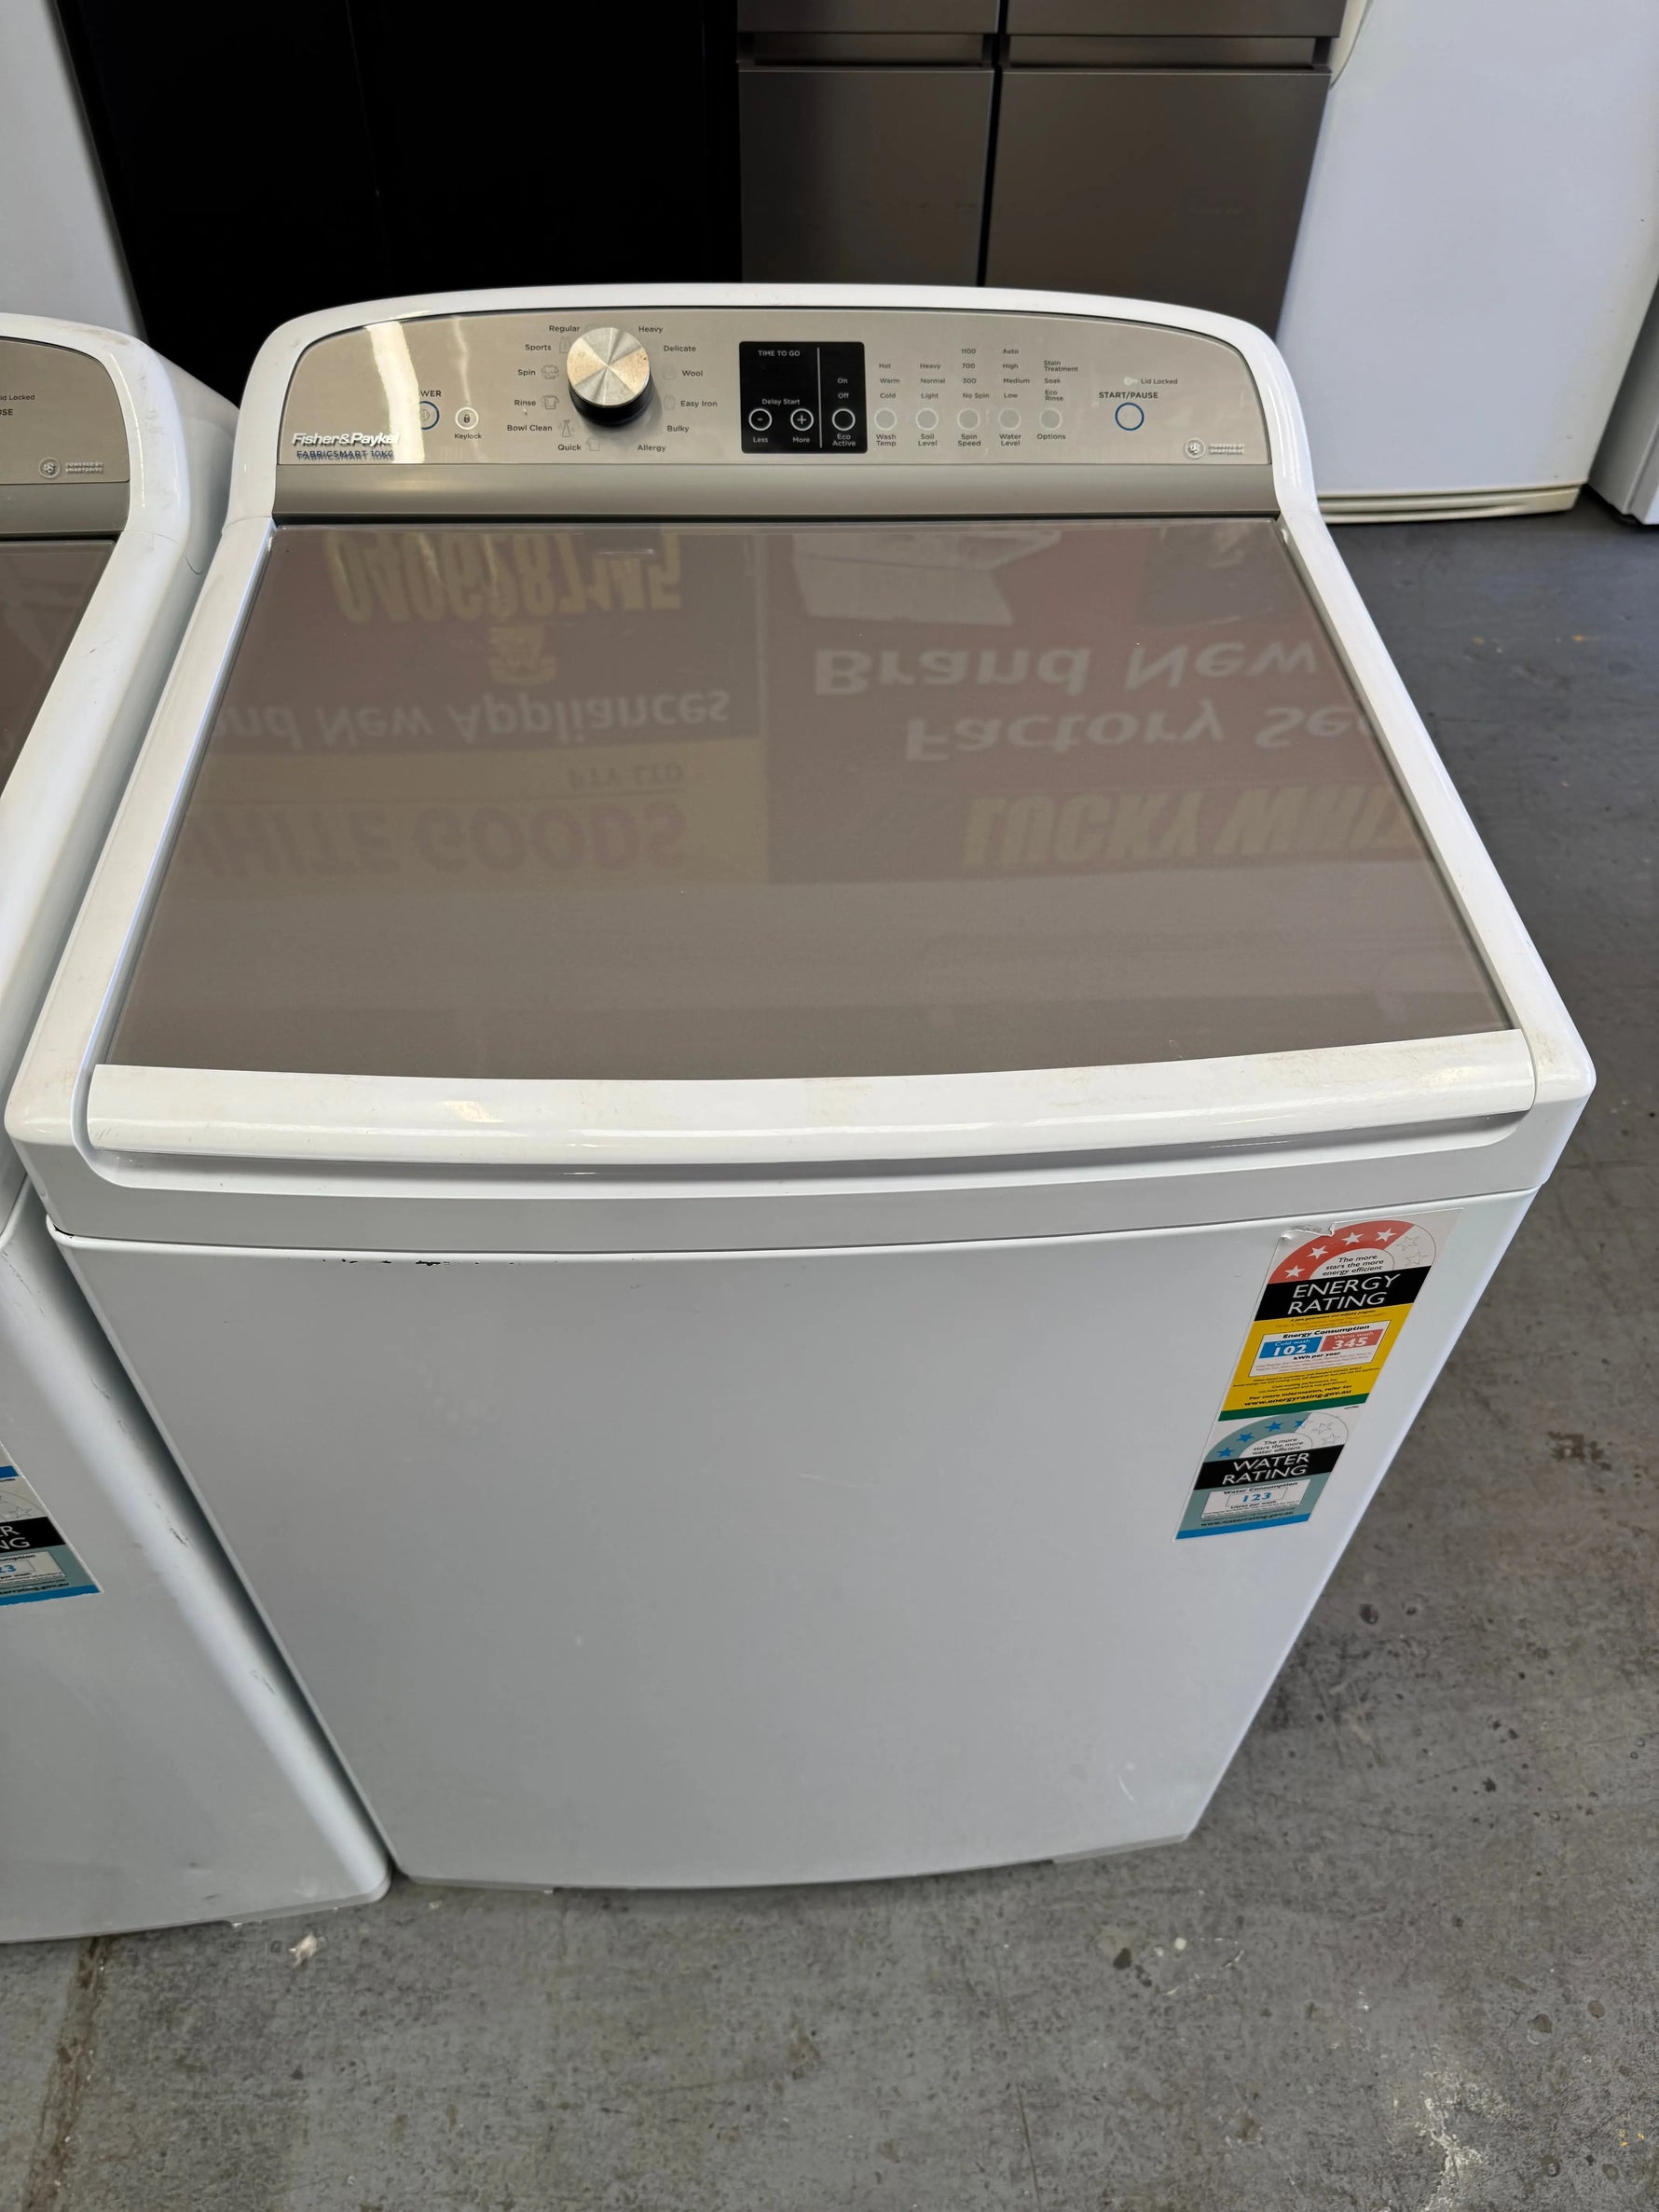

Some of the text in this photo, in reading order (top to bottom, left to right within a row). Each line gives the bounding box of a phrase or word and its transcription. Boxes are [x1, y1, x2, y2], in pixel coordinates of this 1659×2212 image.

[549, 325, 580, 334] Regular
[638, 325, 664, 334] Heavy
[680, 400, 699, 408] Easy
[637, 445, 666, 453] Allergy
[296, 450, 367, 460] FABRICSMART
[1351, 1265, 1382, 1273] efficient
[1292, 1273, 1401, 1298] ENERGY
[1287, 1291, 1388, 1315] RATING
[1314, 1325, 1370, 1335] Consumption
[1332, 1337, 1368, 1350] 345
[1273, 1345, 1307, 1357] 102
[1233, 1452, 1309, 1472] WATER
[1222, 1464, 1309, 1485] RATING
[1242, 1492, 1271, 1503] 123
[0, 1564, 16, 1573] 23
